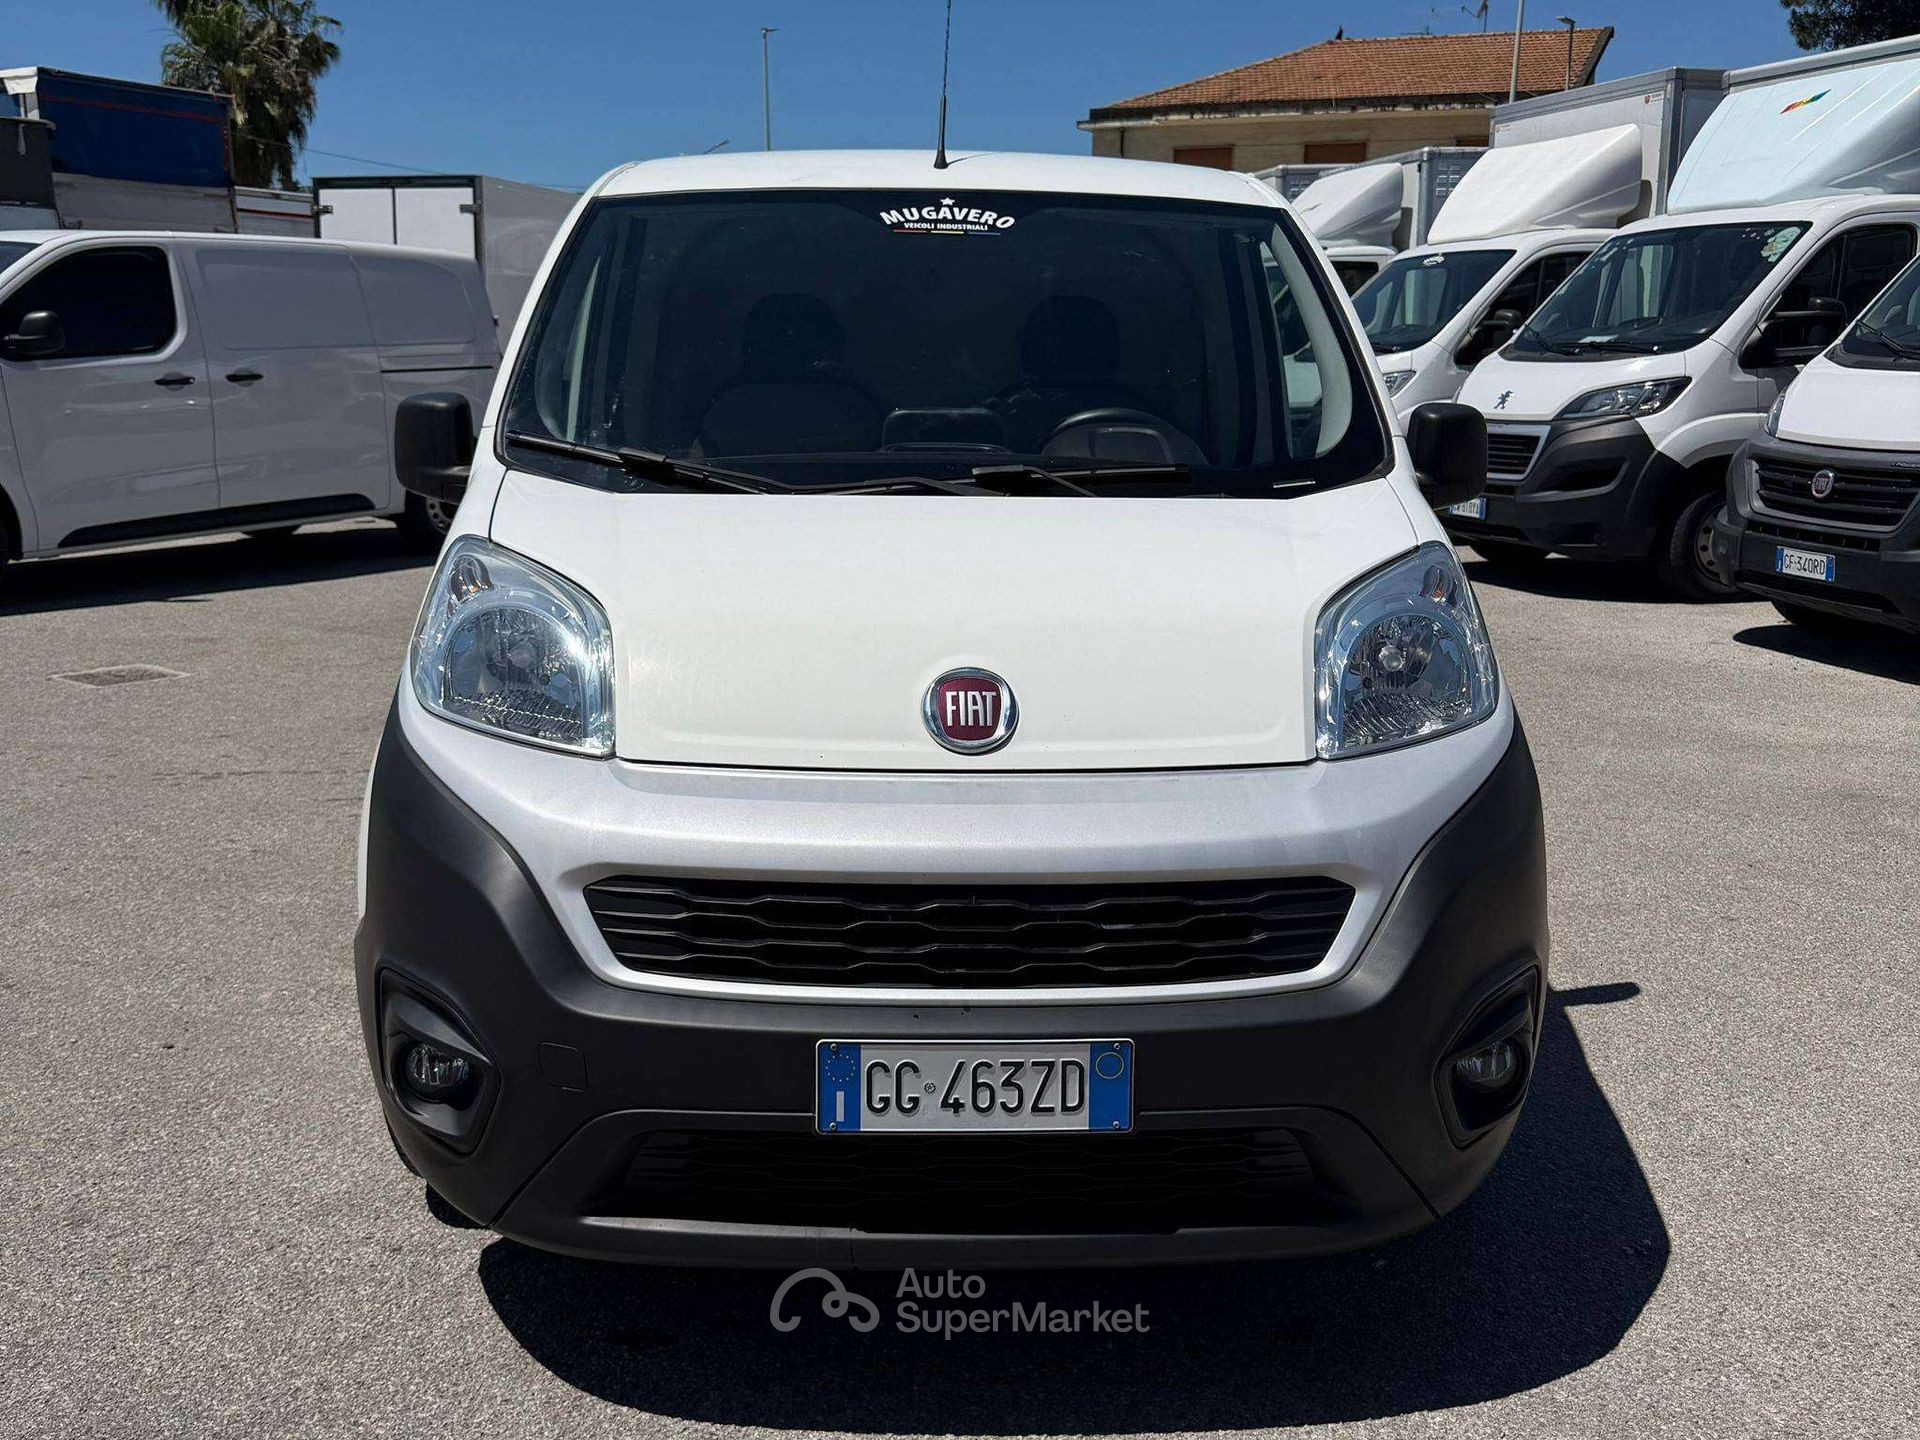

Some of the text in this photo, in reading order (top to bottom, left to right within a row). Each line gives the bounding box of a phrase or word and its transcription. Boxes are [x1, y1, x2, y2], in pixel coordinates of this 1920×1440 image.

[880, 206, 1015, 228] MUGAVERO
[904, 222, 988, 231] VEICOLI INDUSTRIALI
[945, 691, 997, 727] FIAT
